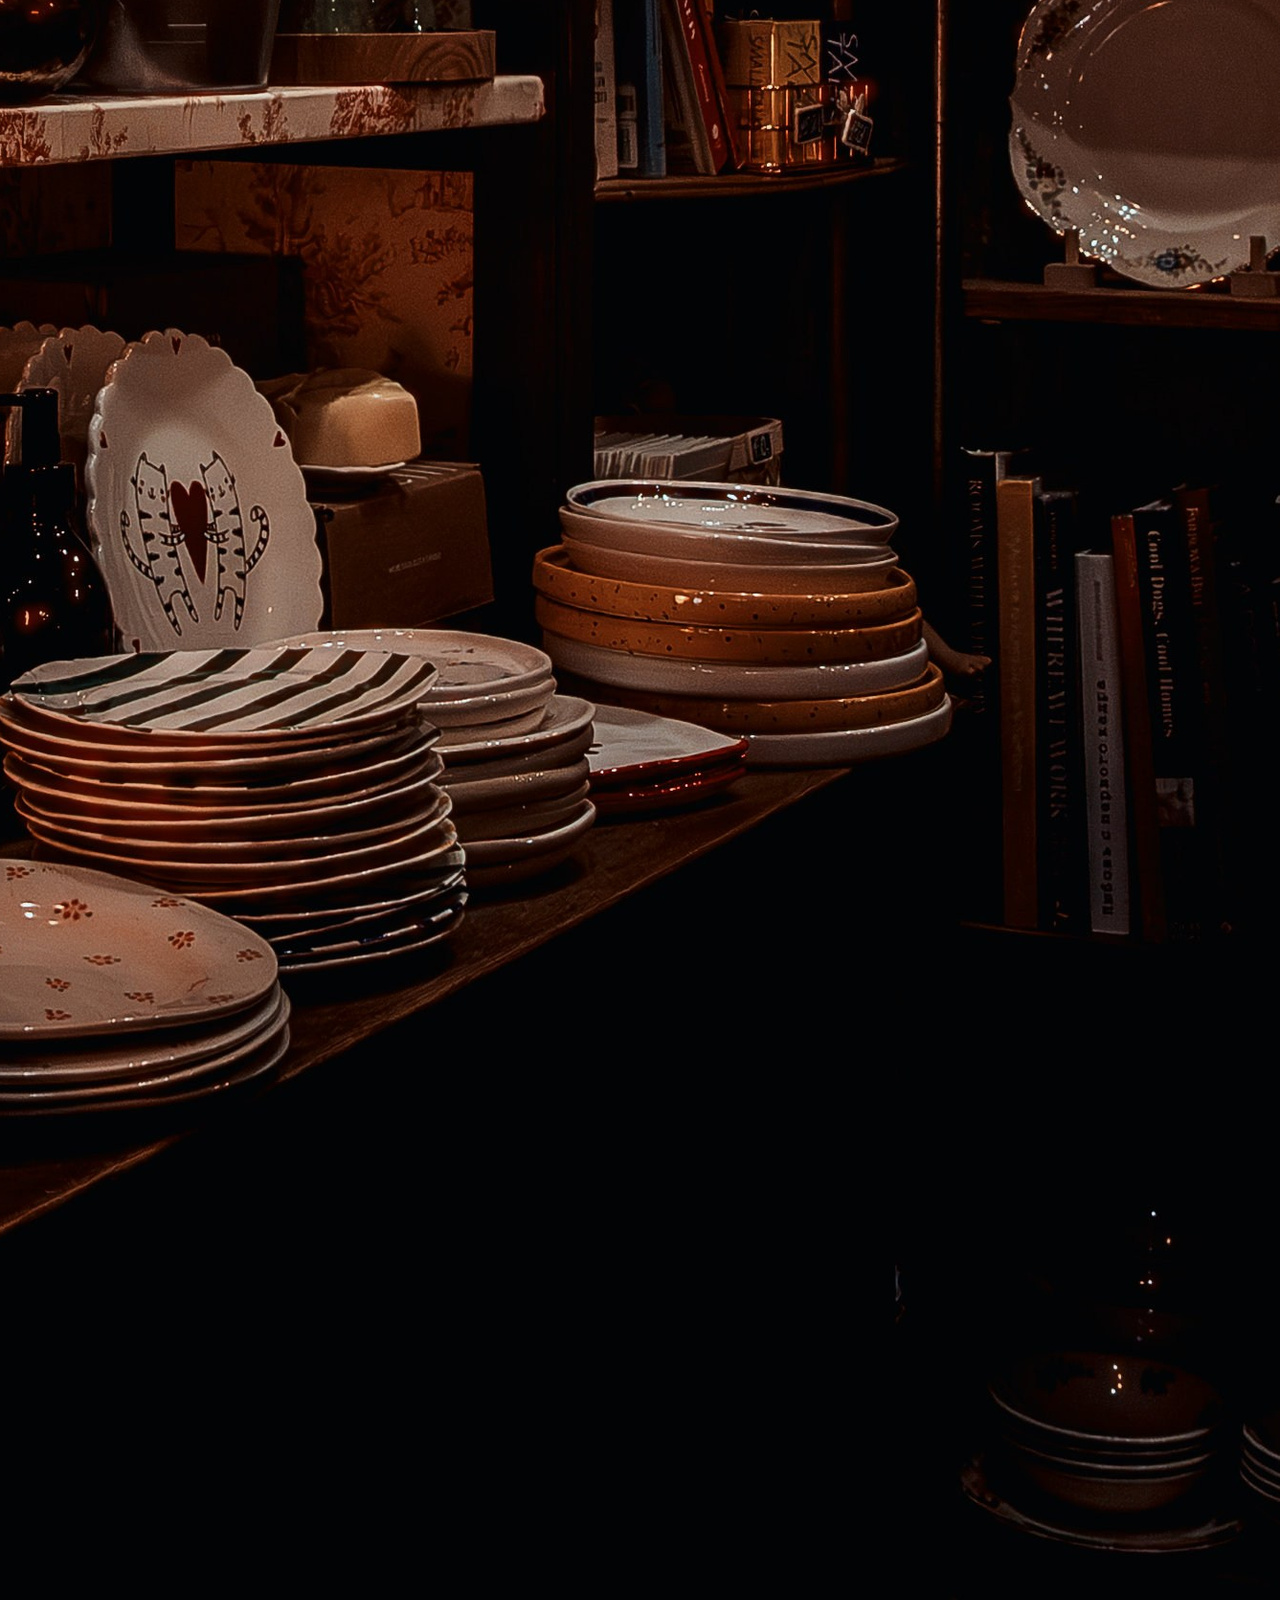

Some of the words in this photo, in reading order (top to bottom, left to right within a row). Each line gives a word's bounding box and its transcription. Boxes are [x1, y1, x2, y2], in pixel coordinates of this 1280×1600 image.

[1147, 530, 1164, 570] Cool
[1155, 632, 1172, 671] Cool
[1159, 678, 1174, 740] Homes
